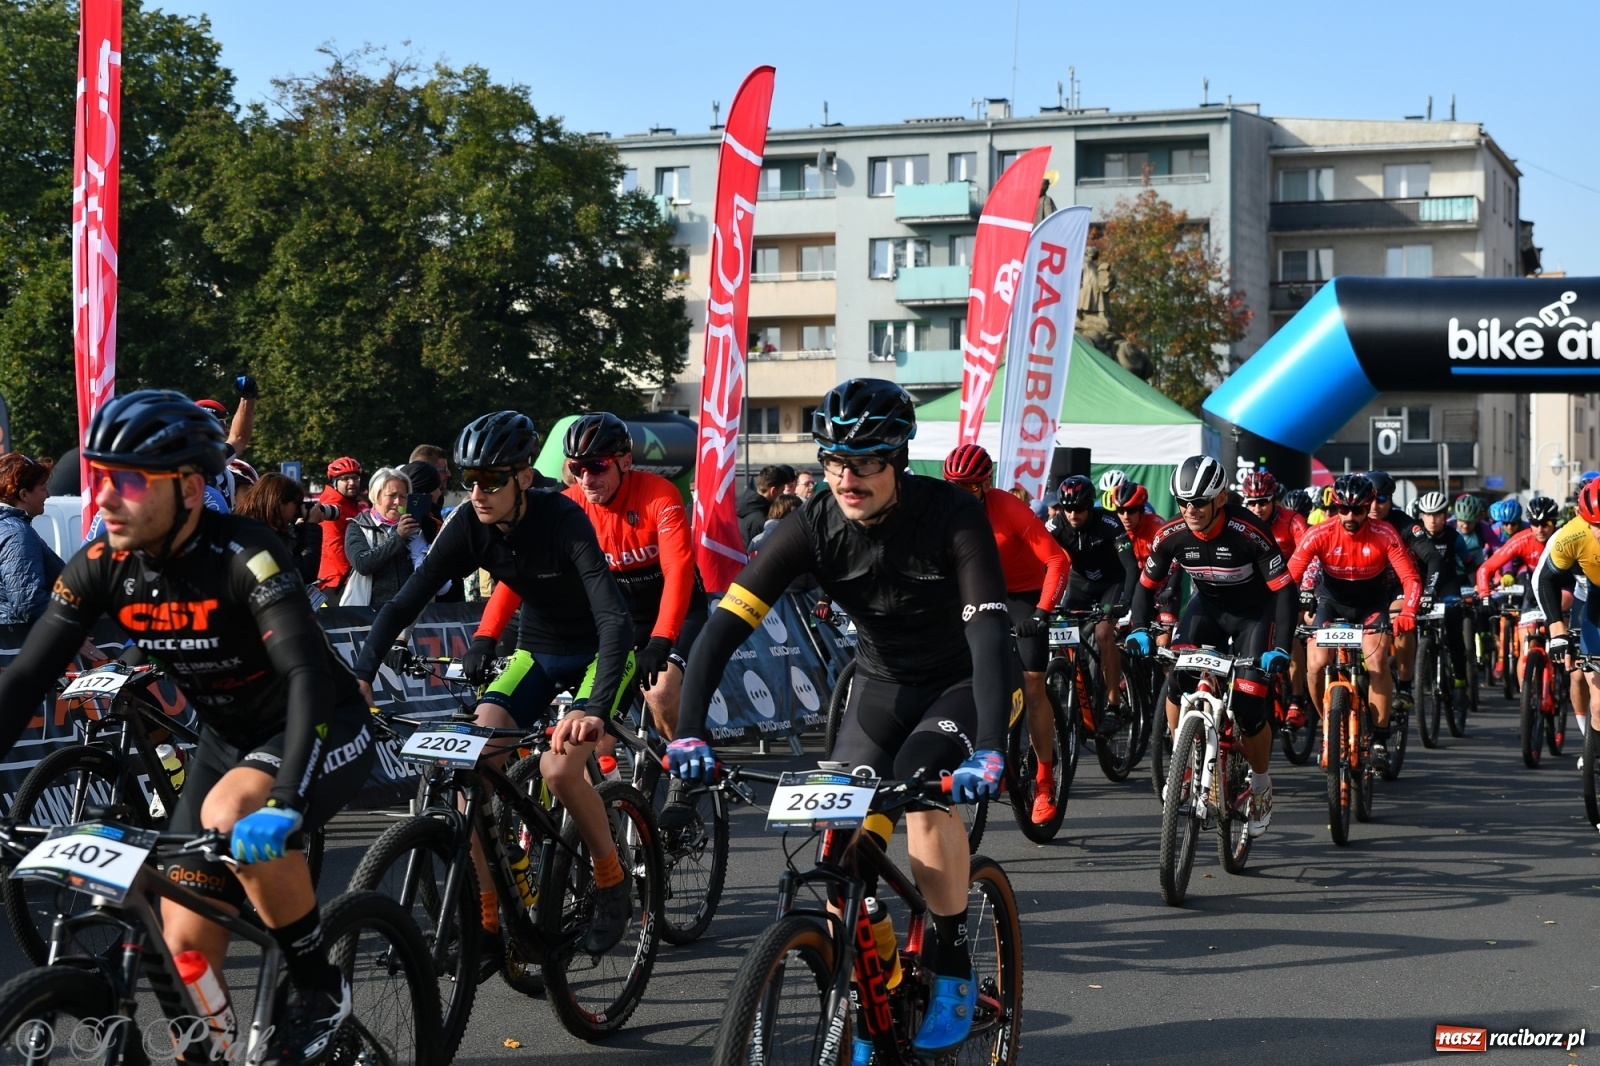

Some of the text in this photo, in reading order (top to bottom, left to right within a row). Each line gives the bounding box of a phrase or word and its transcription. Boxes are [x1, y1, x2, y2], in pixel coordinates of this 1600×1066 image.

[1448, 317, 1545, 360] bike
[1377, 428, 1398, 456] 0
[117, 598, 218, 632] CST
[725, 593, 762, 621] PROTAN
[1049, 630, 1073, 641] 1117
[1324, 631, 1354, 640] 1628
[1186, 656, 1222, 668] 1953
[78, 676, 115, 689] 1177
[711, 726, 745, 740] KOKOwear
[757, 719, 792, 733] KOKOwear
[416, 736, 472, 753] 2202
[786, 792, 854, 811] 2635
[43, 842, 122, 868] 1407
